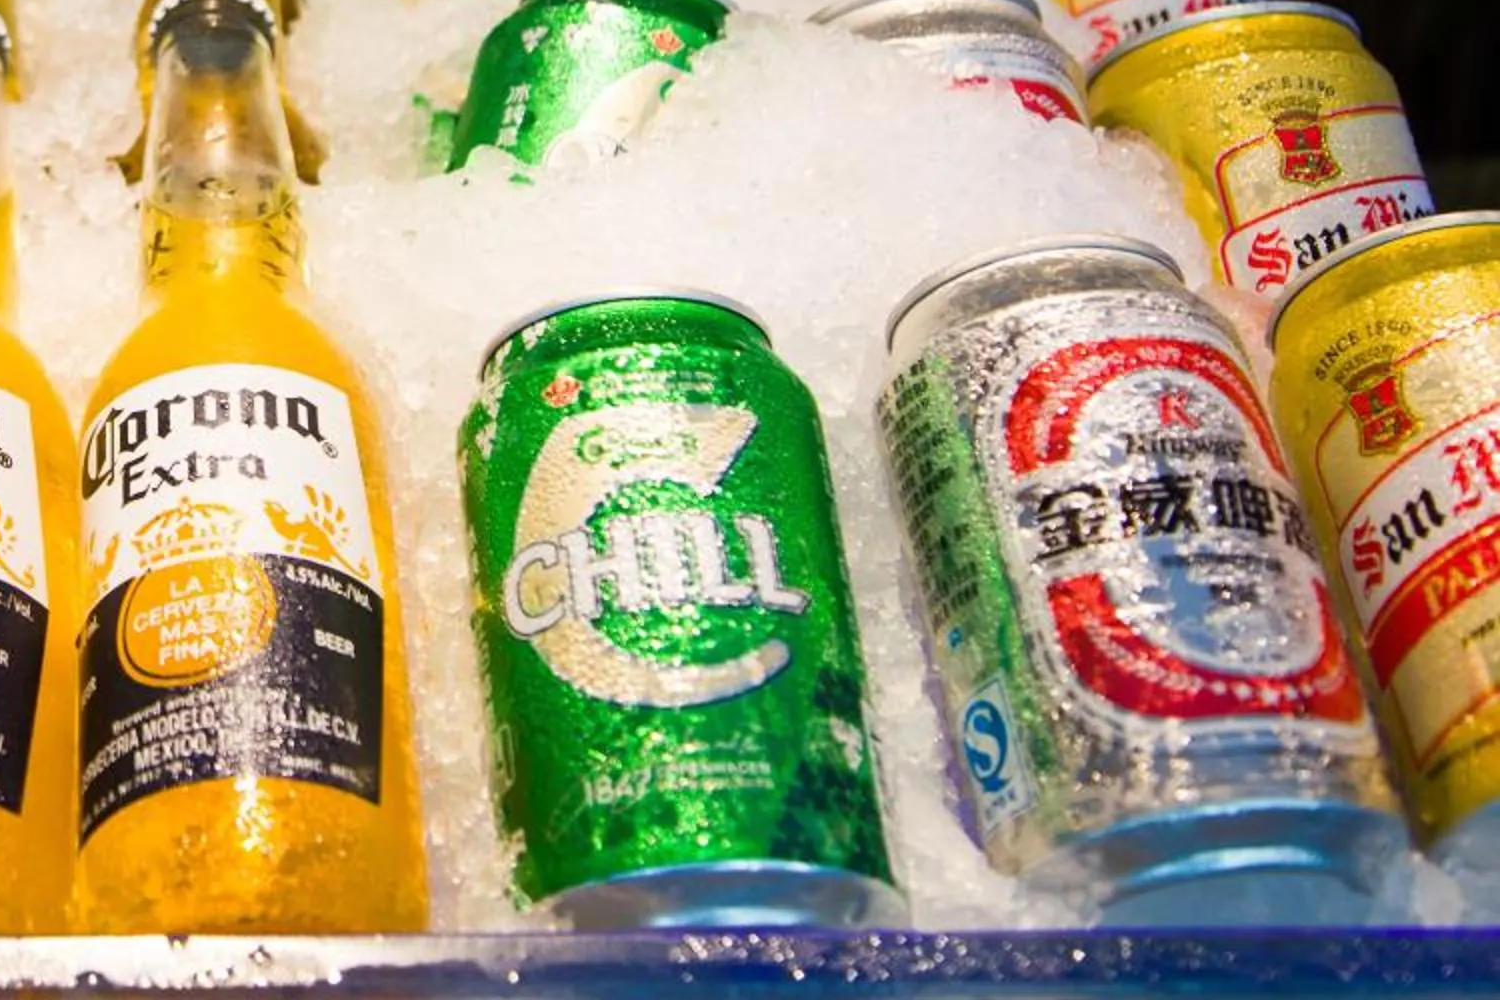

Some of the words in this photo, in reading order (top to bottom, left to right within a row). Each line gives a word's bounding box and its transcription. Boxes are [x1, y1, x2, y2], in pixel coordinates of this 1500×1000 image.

[1248, 222, 1350, 294] San
[1315, 331, 1360, 382] SINCE
[81, 385, 328, 501] Corona
[120, 449, 269, 508] Extra
[1353, 486, 1447, 600] San
[169, 576, 202, 599] LA
[502, 511, 812, 640] CHILL
[157, 636, 218, 666] FINA
[159, 616, 219, 645] MAS
[313, 628, 356, 659] BEER
